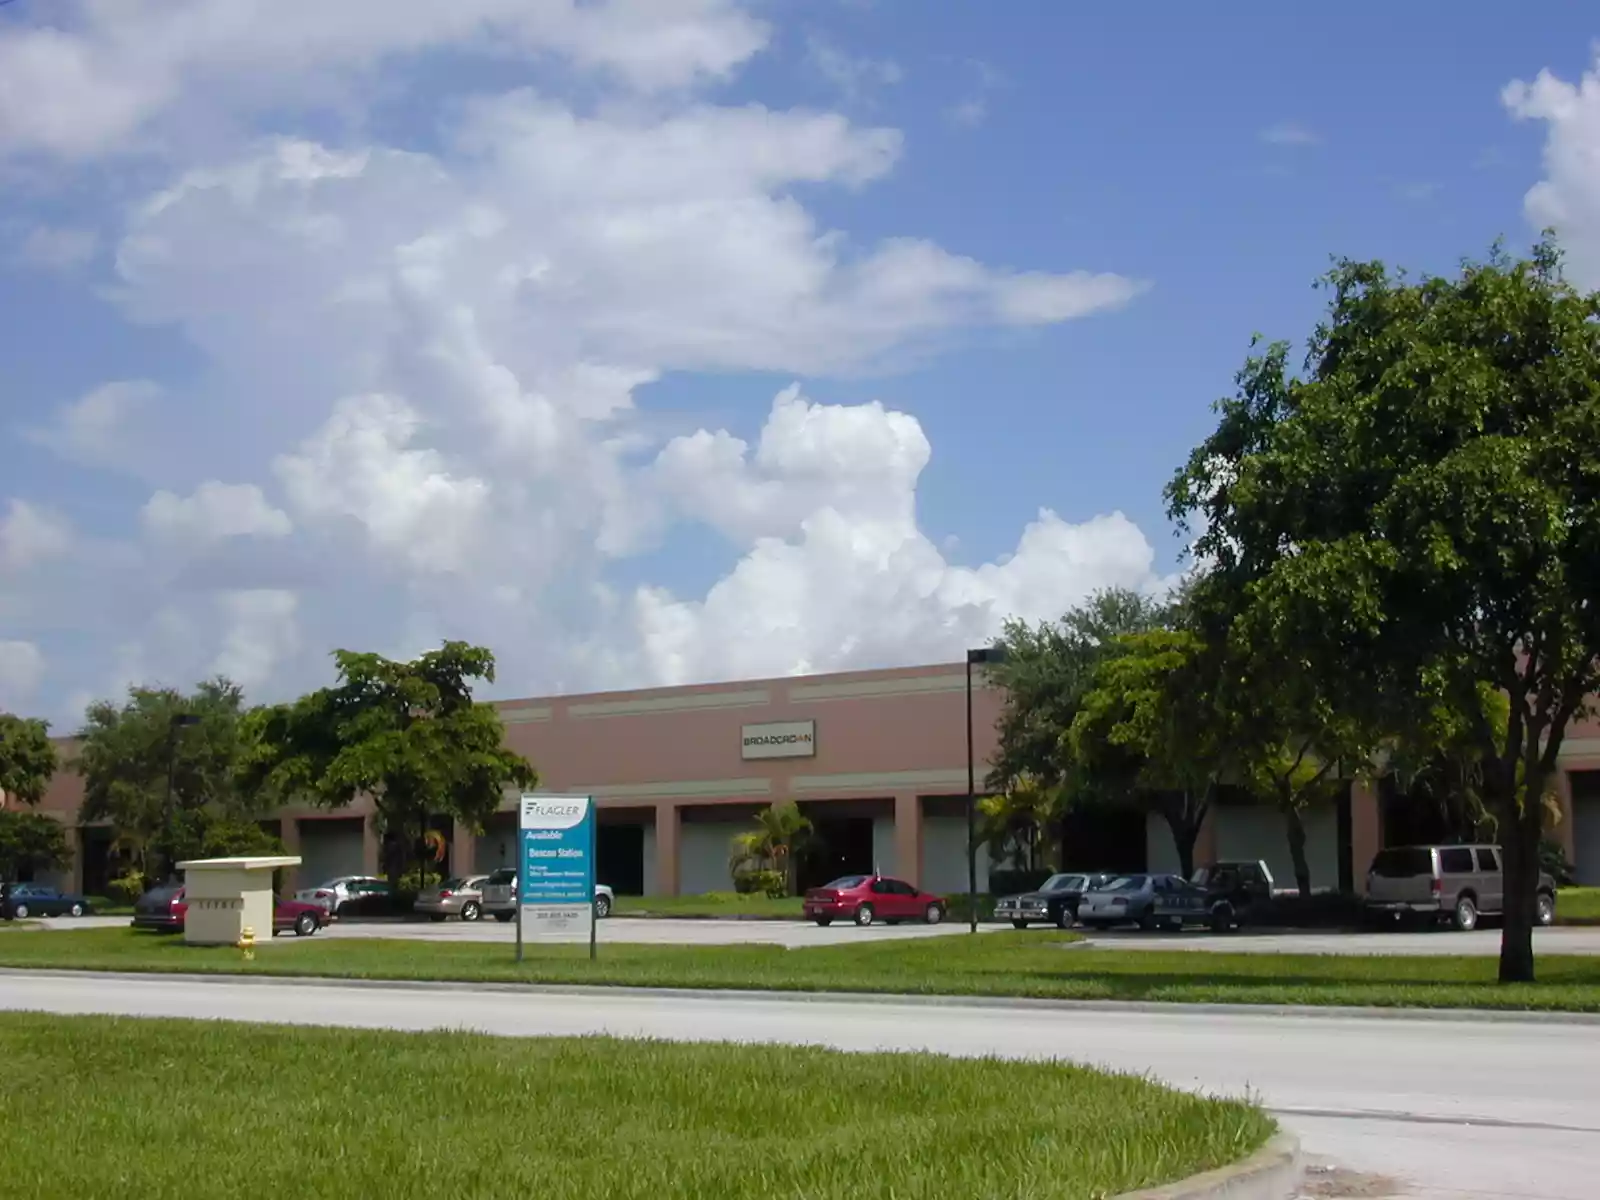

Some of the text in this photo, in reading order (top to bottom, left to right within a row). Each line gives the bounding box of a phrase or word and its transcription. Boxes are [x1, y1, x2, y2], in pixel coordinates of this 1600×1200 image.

[534, 805, 579, 816] FLAGLER
[525, 830, 563, 840] Available
[558, 847, 584, 858] Station
